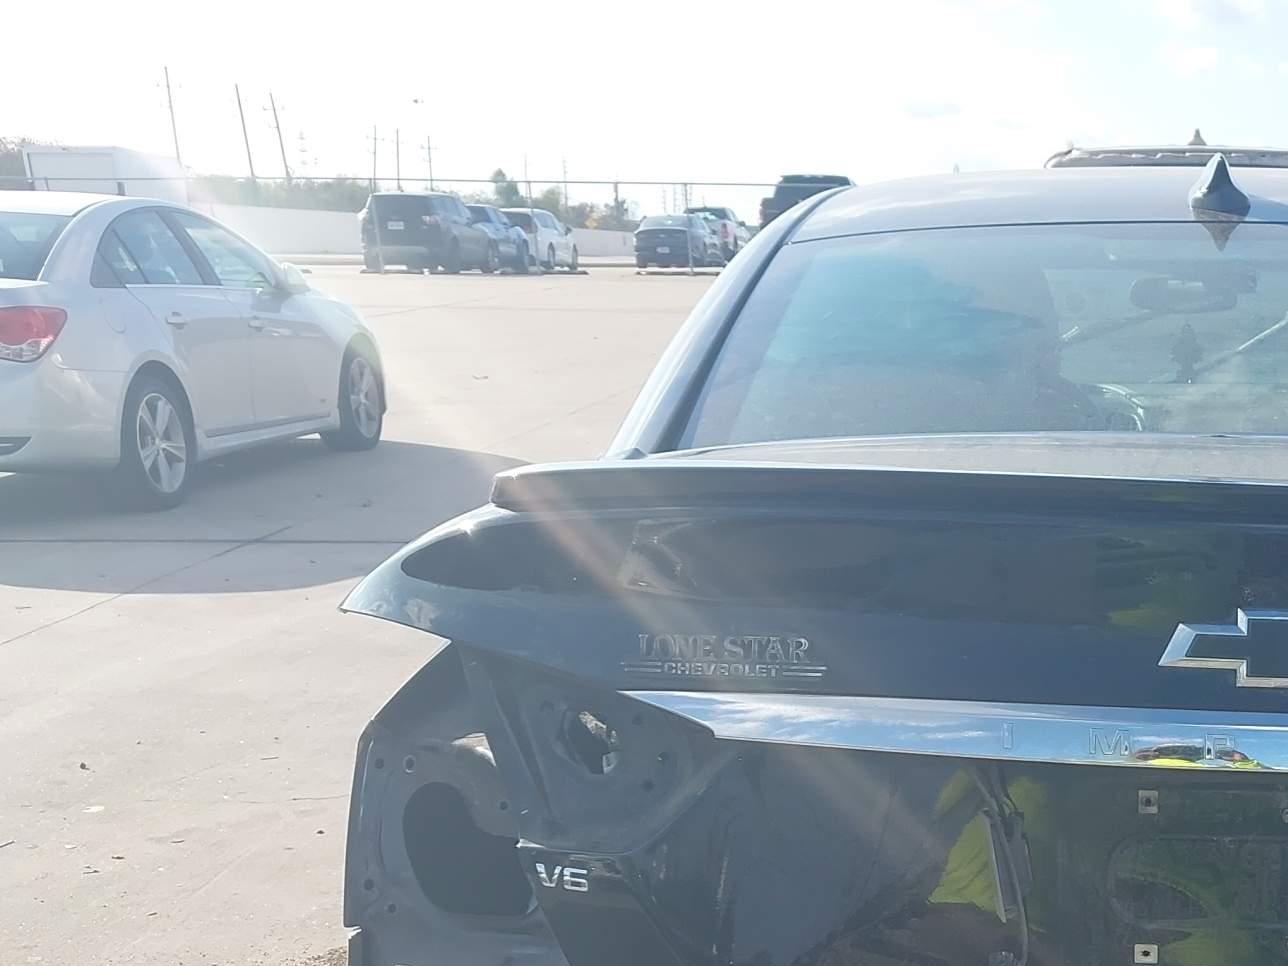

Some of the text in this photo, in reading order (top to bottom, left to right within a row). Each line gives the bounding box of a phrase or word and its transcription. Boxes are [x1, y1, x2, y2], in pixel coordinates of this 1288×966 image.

[723, 636, 810, 664] STAR
[664, 662, 780, 678] CHEVROLET
[536, 863, 588, 892] V6
